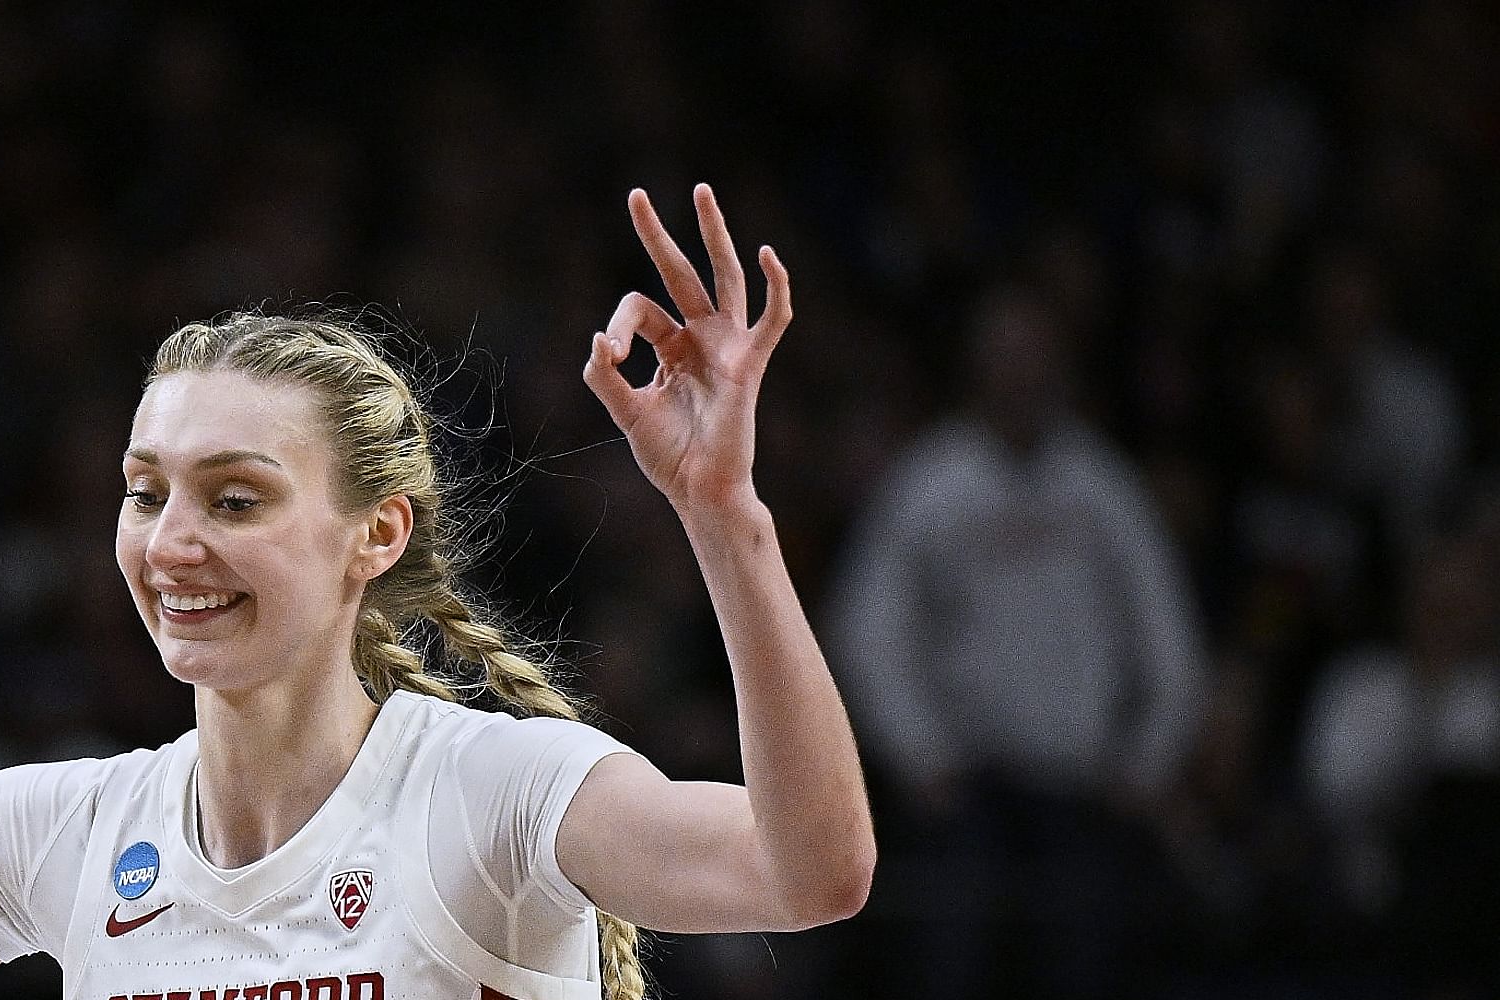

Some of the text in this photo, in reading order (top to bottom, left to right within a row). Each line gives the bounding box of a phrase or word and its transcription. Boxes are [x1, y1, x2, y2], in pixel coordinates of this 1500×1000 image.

[118, 866, 156, 887] NCAA
[331, 872, 371, 909] PAC
[340, 895, 362, 919] 12
